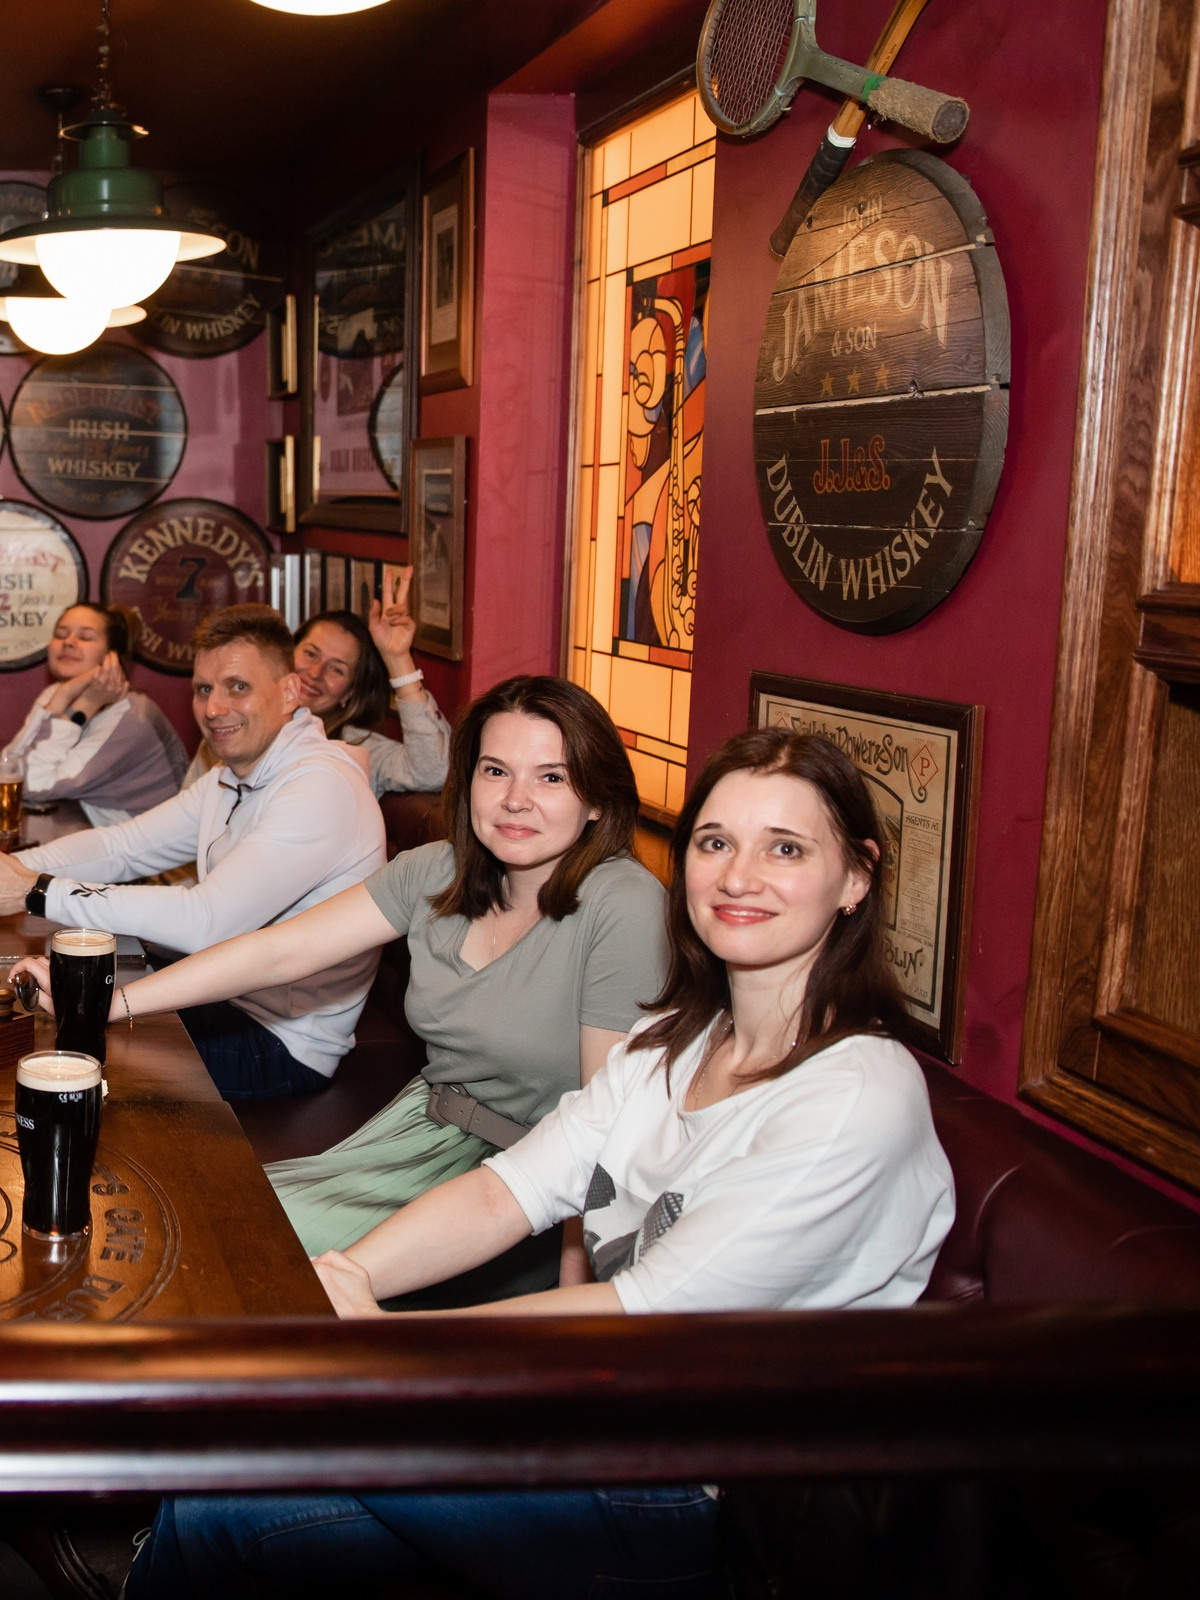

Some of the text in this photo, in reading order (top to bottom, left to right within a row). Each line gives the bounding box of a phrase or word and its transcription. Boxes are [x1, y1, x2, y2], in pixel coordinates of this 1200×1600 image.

[837, 196, 883, 234] JOHN
[184, 293, 262, 341] WHISKEY
[772, 229, 953, 383] JAMESON
[831, 321, 878, 357] & SON
[68, 418, 130, 441] IRISH
[47, 456, 142, 479] WHISKEY
[766, 447, 953, 602] DUBLIN WHISKEY
[118, 516, 266, 589] KENNEDY'S
[176, 556, 208, 599] 7
[919, 756, 931, 777] P
[905, 815, 940, 831] AGENTS AT
[16, 1112, 35, 1130] NESS
